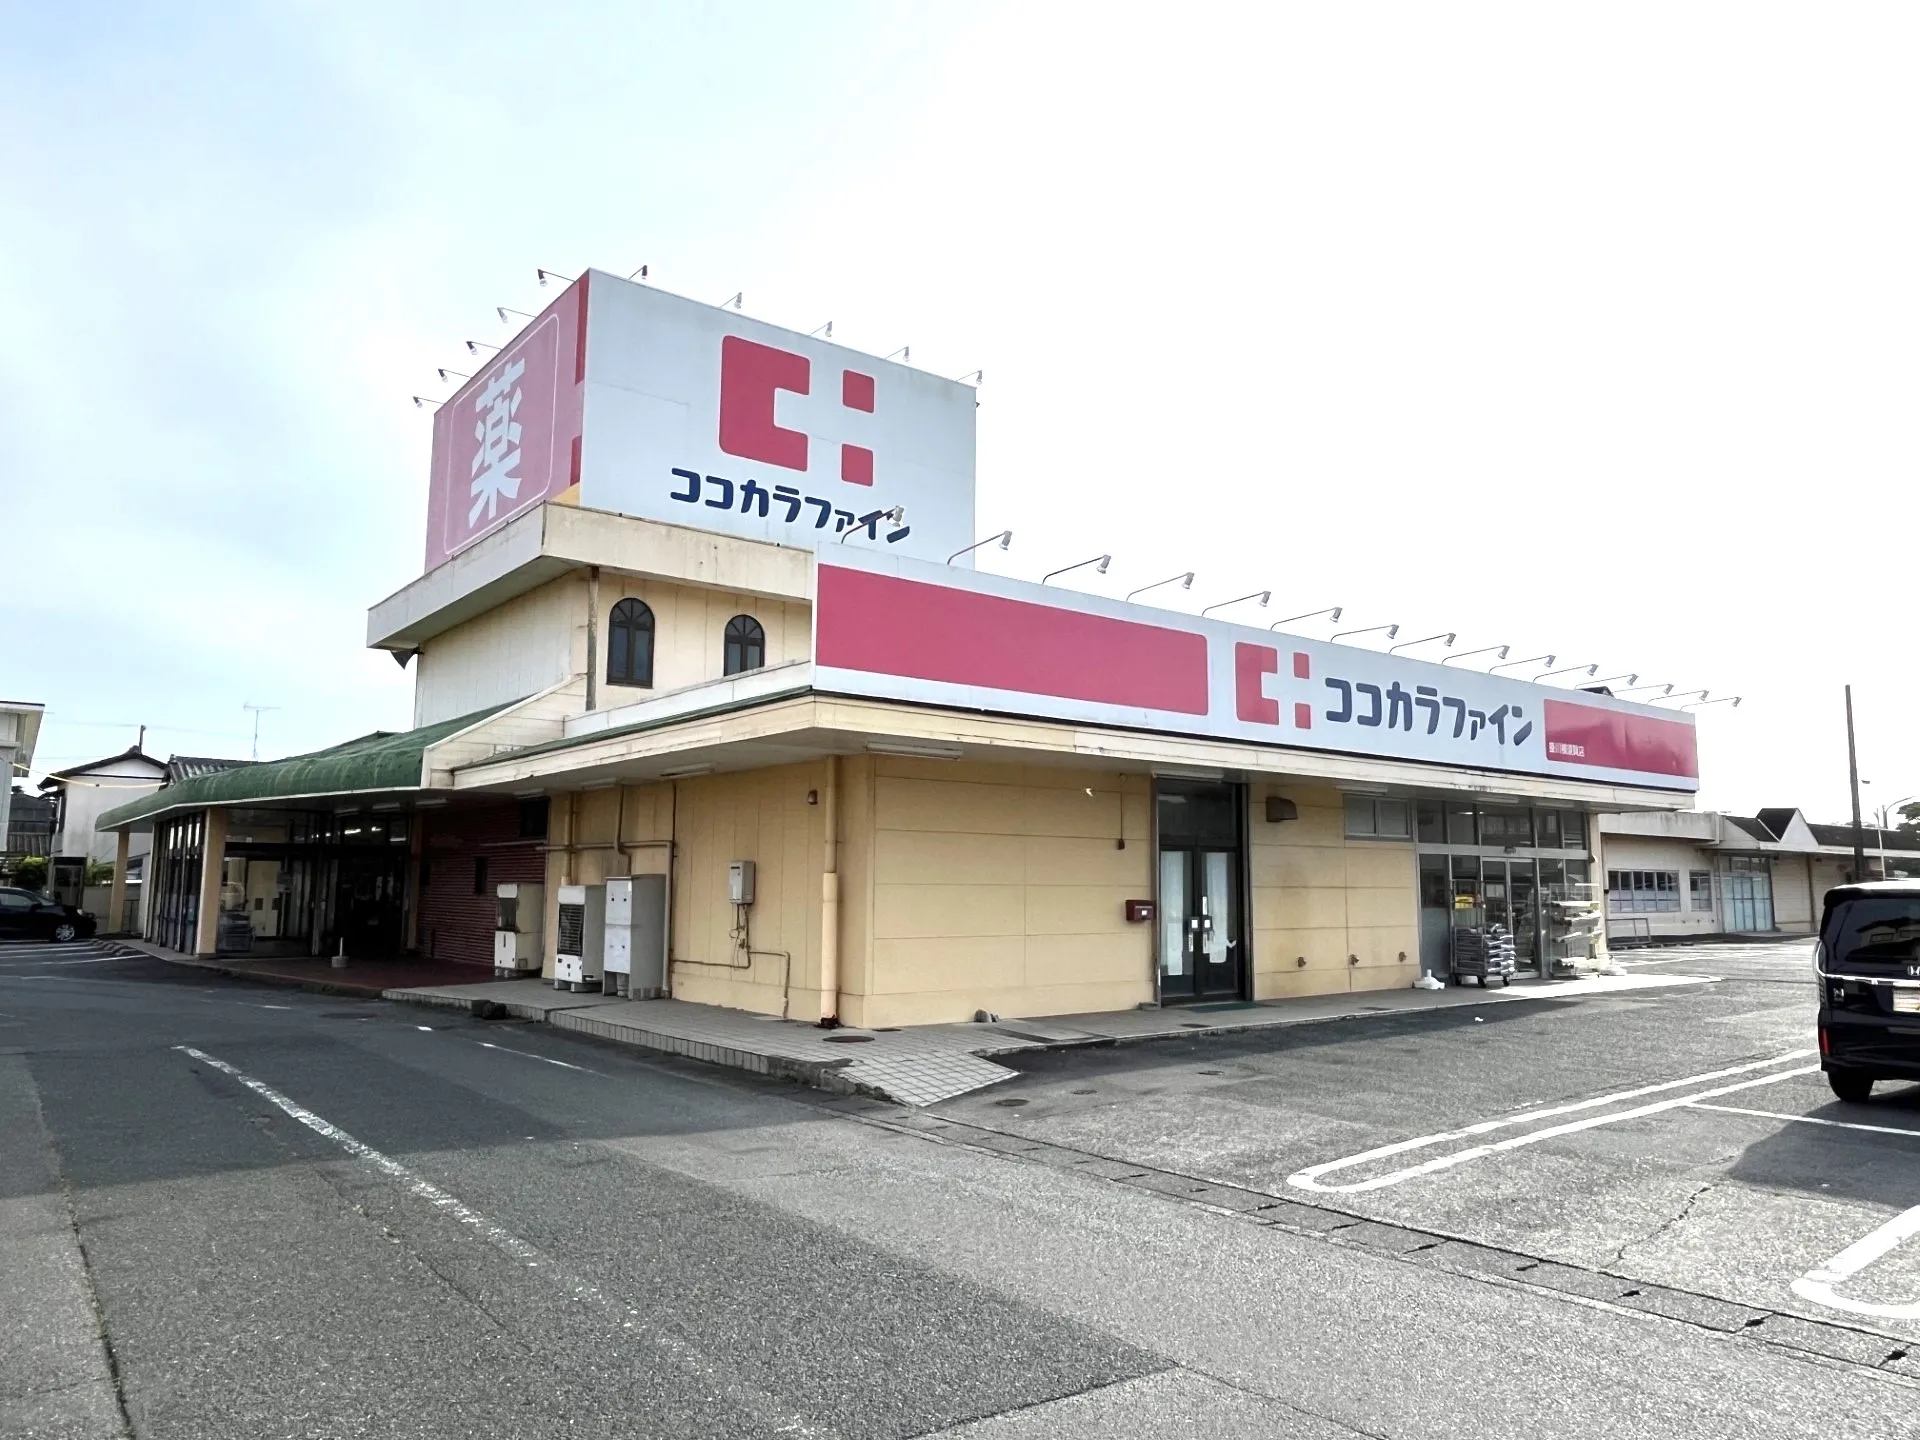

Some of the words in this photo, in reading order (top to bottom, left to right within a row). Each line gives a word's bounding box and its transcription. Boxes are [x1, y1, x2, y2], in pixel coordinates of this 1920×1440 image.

[469, 358, 525, 529] 薬
[670, 467, 911, 543] ココカラファイン
[1325, 678, 1533, 747] ココカラファイン
